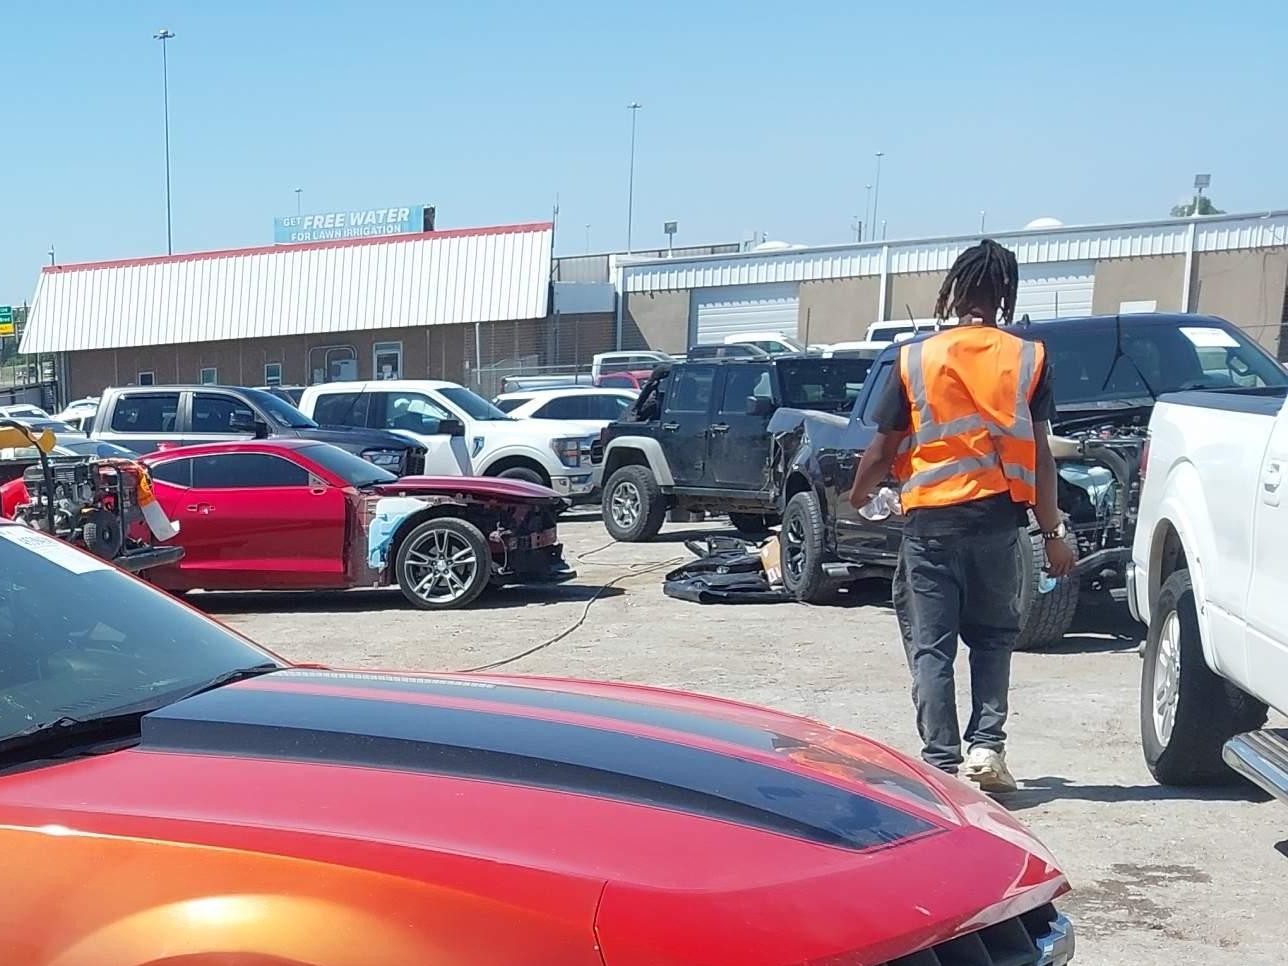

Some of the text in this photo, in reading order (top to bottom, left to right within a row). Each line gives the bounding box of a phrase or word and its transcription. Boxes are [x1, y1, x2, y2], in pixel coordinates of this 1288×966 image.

[283, 207, 411, 230] GET FREE WATER
[291, 224, 402, 242] FOR LAWN IRRIGATION
